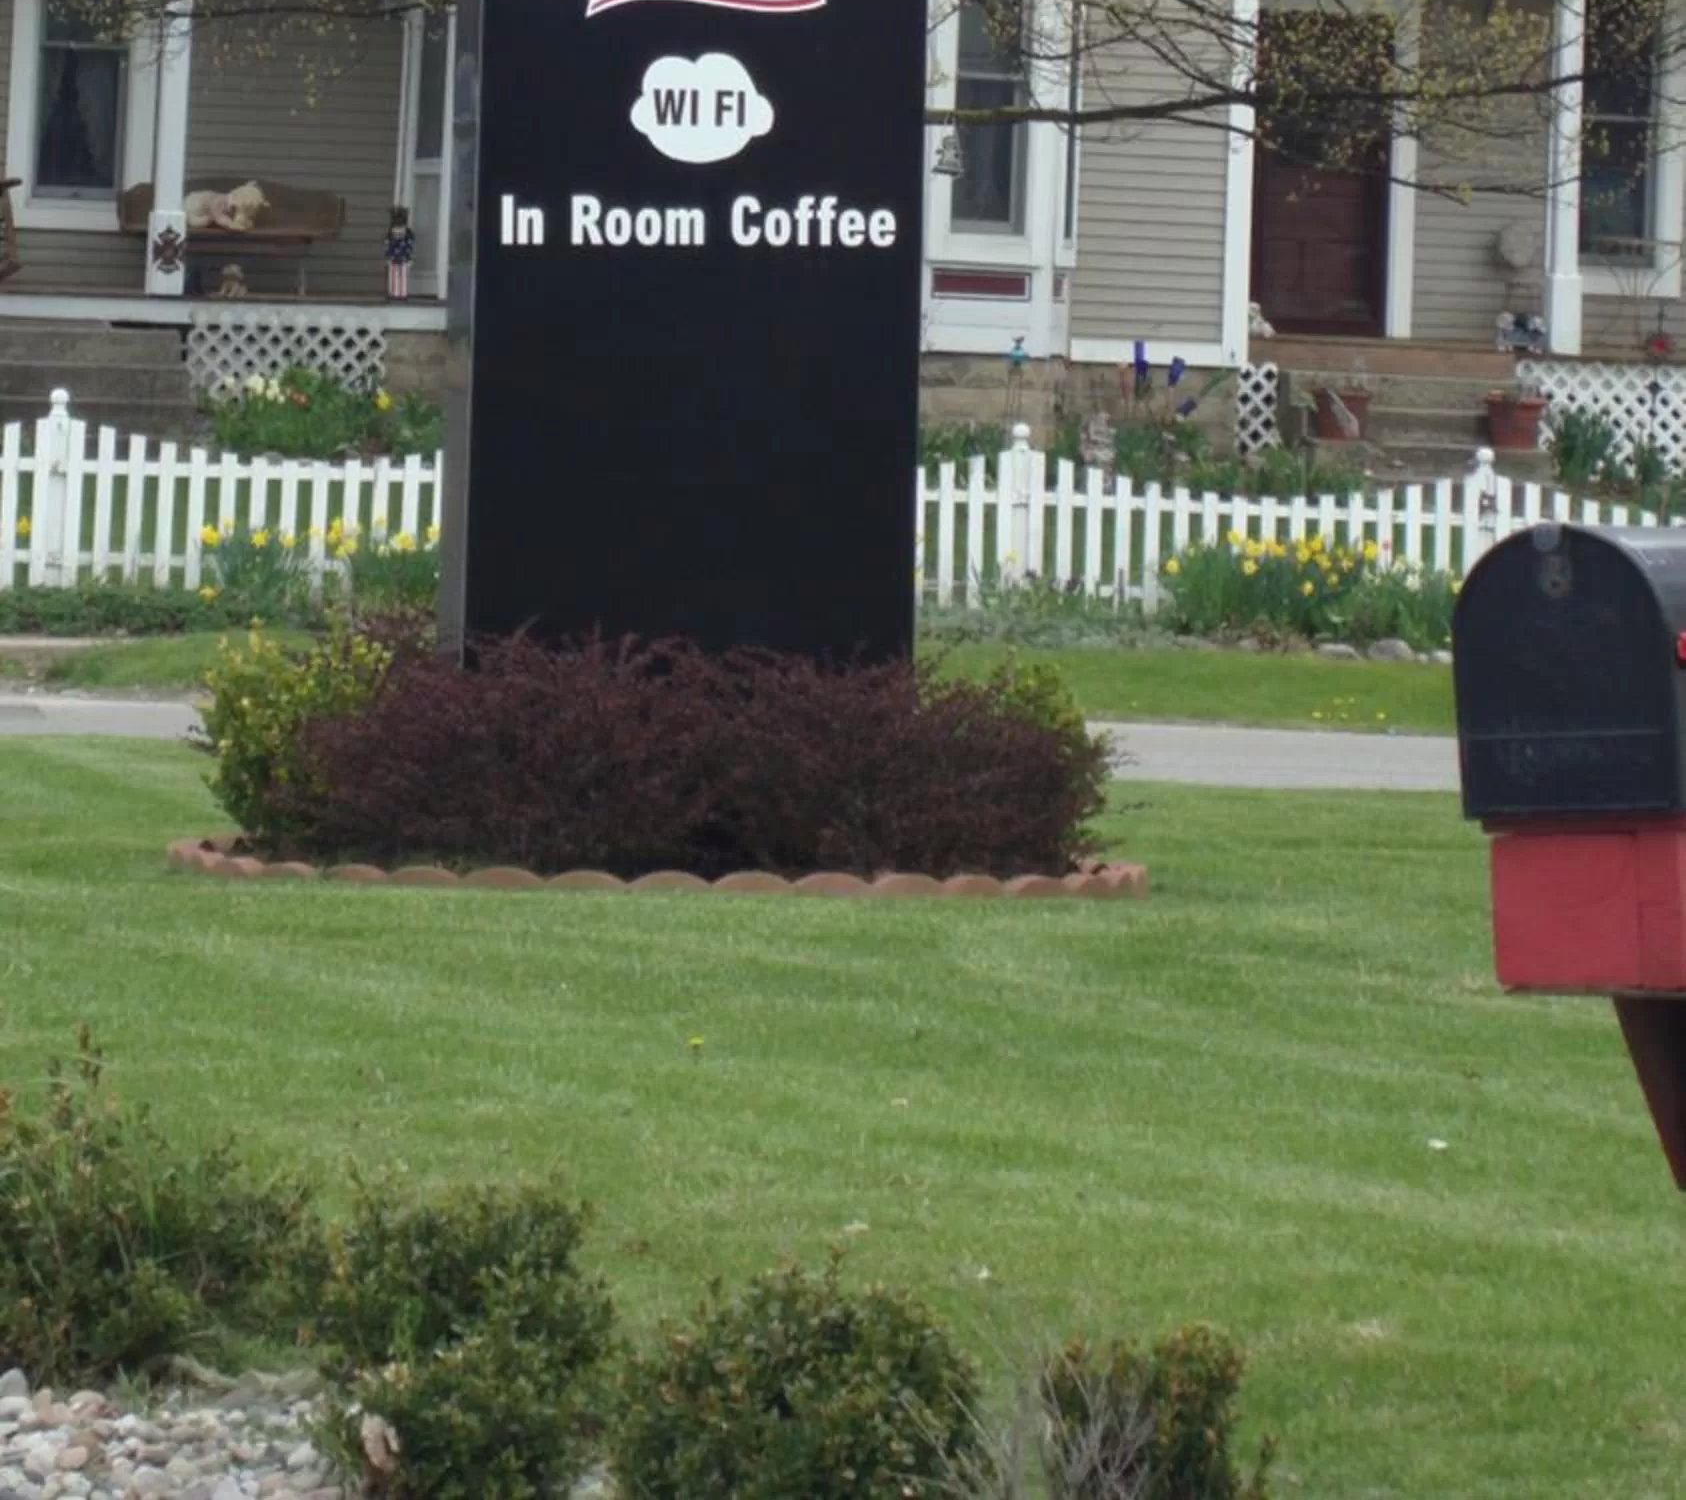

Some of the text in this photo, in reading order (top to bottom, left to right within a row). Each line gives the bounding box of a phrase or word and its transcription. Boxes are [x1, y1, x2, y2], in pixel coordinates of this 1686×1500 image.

[501, 194, 897, 247] In Room Coffee
